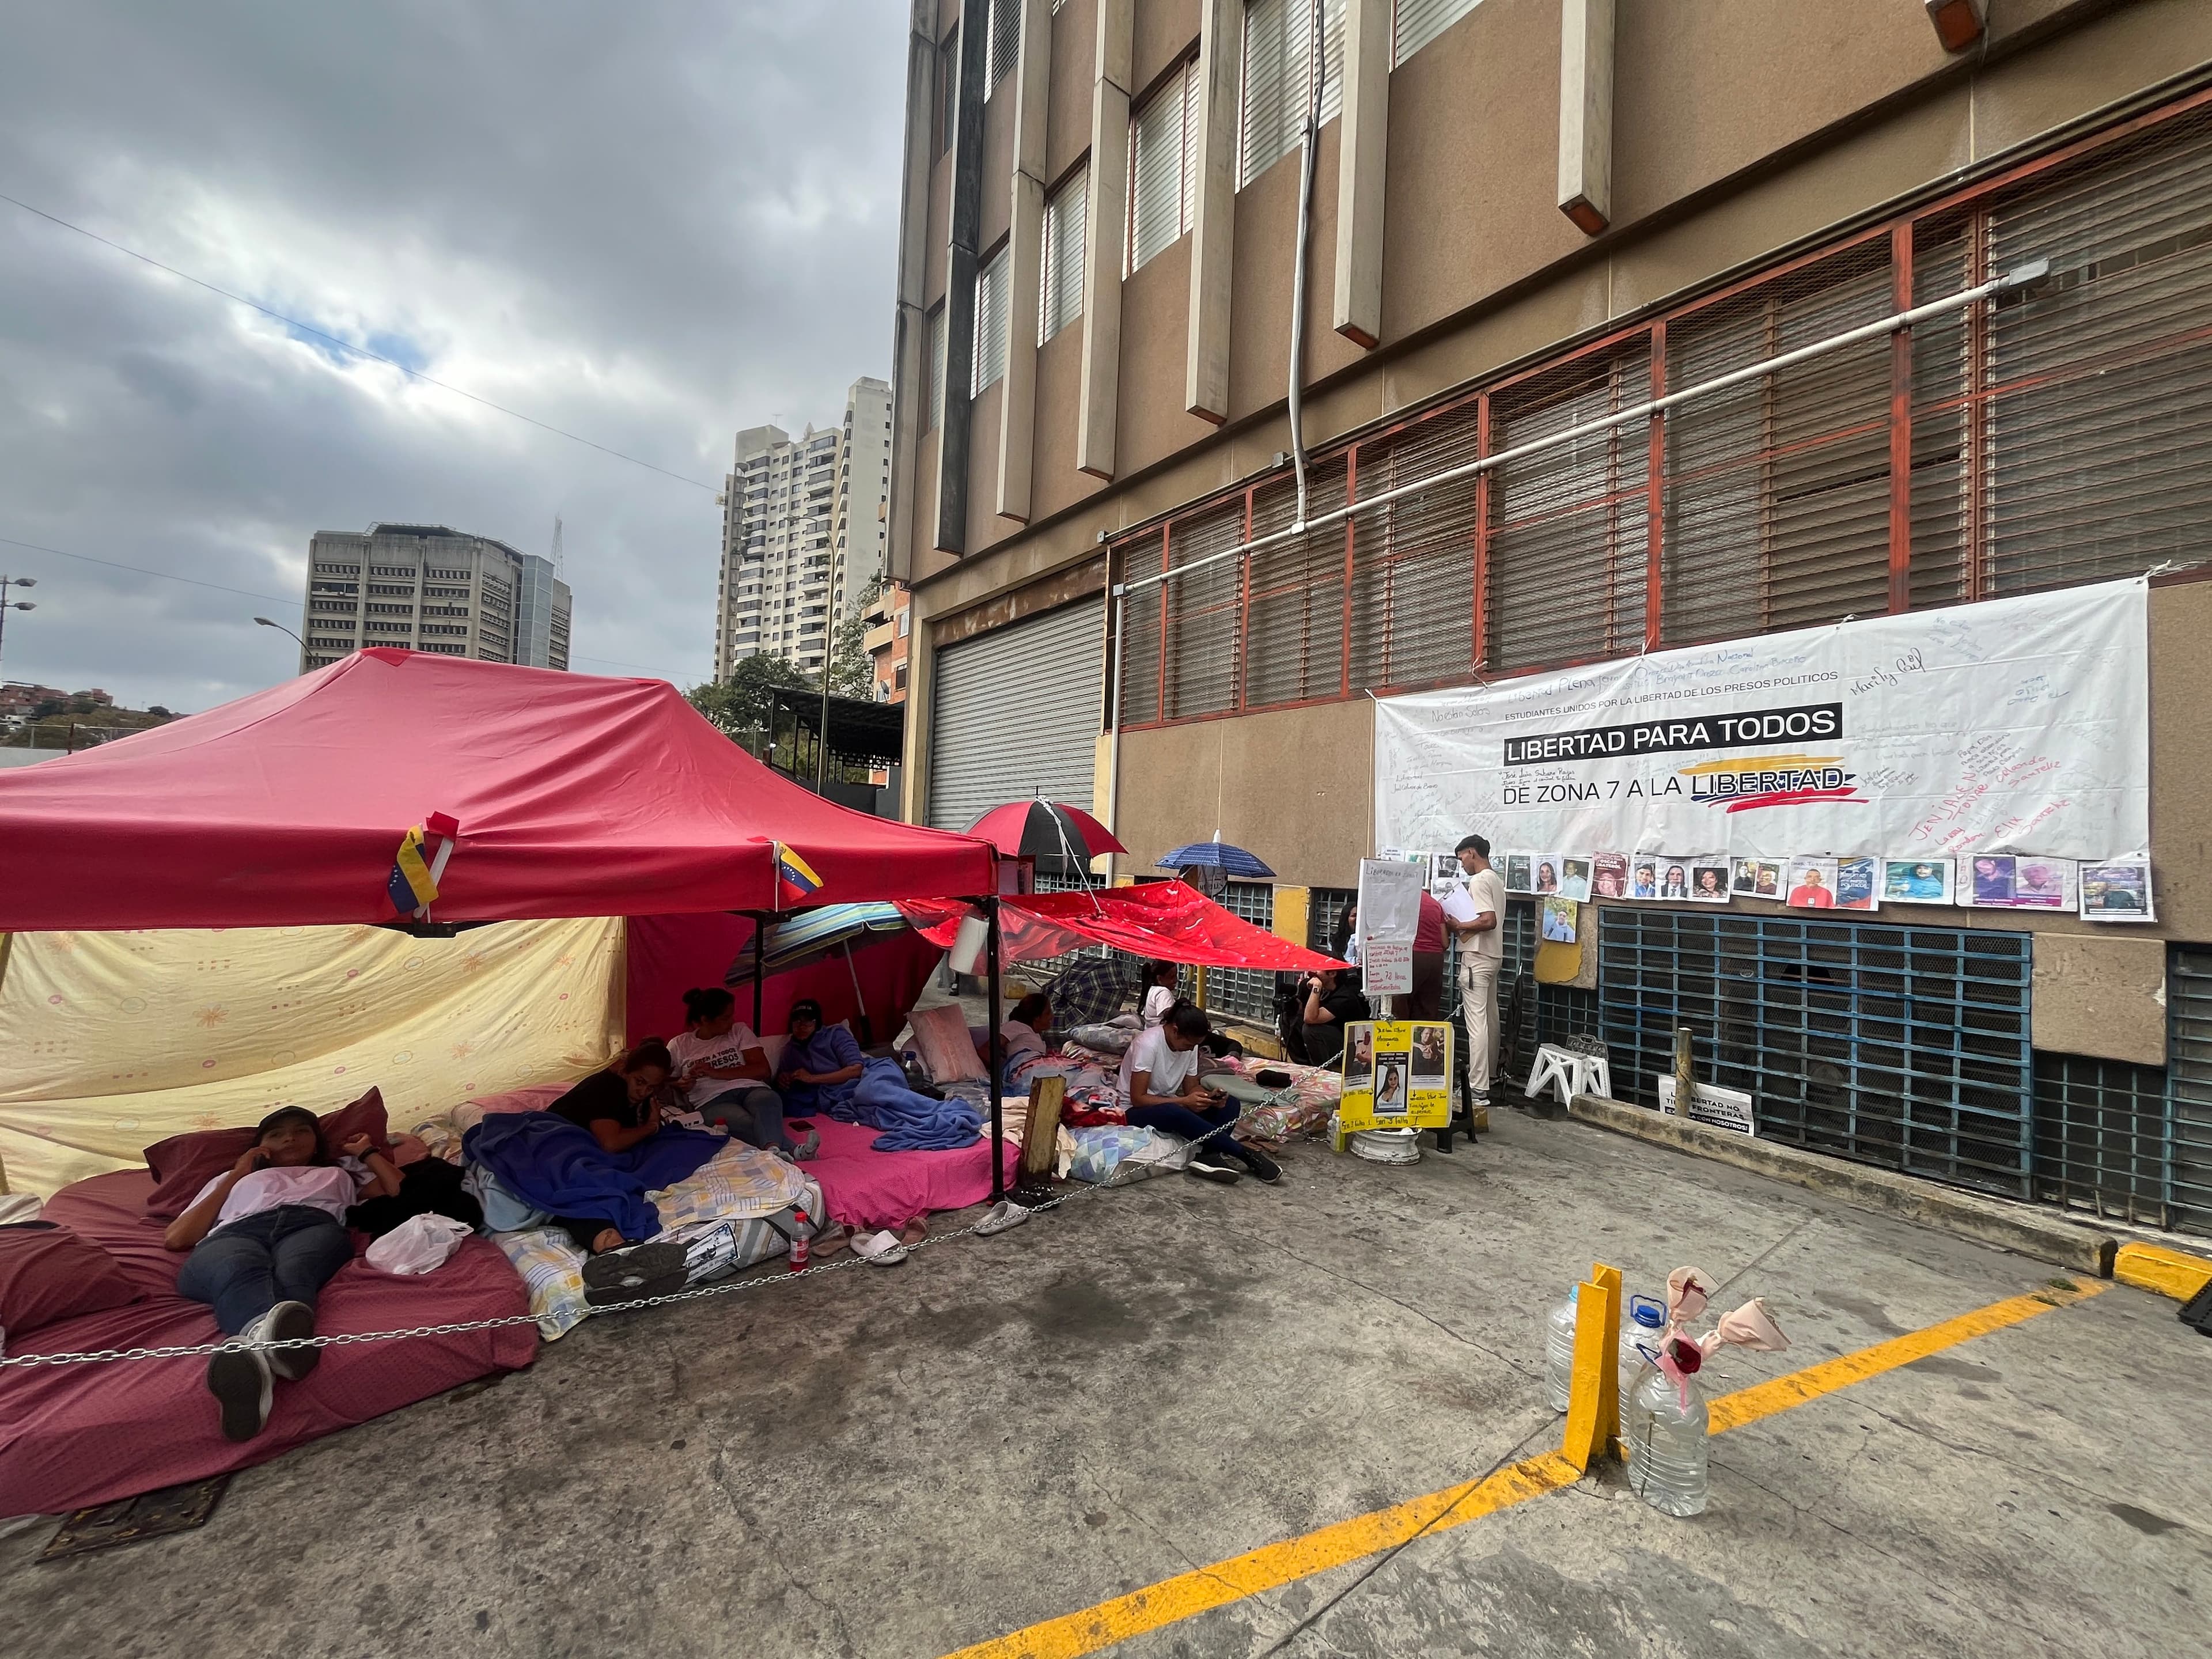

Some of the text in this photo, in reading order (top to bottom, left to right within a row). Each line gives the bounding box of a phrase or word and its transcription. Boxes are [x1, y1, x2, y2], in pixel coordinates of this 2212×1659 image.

[1505, 671, 1838, 721] ESTUDIANTES UNIDOS POR LA LIBERTAD DE LOS PRESOS POLITICOS
[1506, 729, 1626, 762] LIBERTAD
[1633, 721, 1710, 750] PARA
[1718, 710, 1836, 742] TODOS
[1503, 787, 1531, 805] DE
[1536, 782, 1600, 803] ZONA
[1607, 781, 1620, 799] 7
[1626, 779, 1643, 798] A
[1651, 776, 1683, 796] LA
[1691, 767, 1845, 795] LIBERTAD
[1385, 971, 1393, 980] 72
[710, 1053, 739, 1068] RESOS
